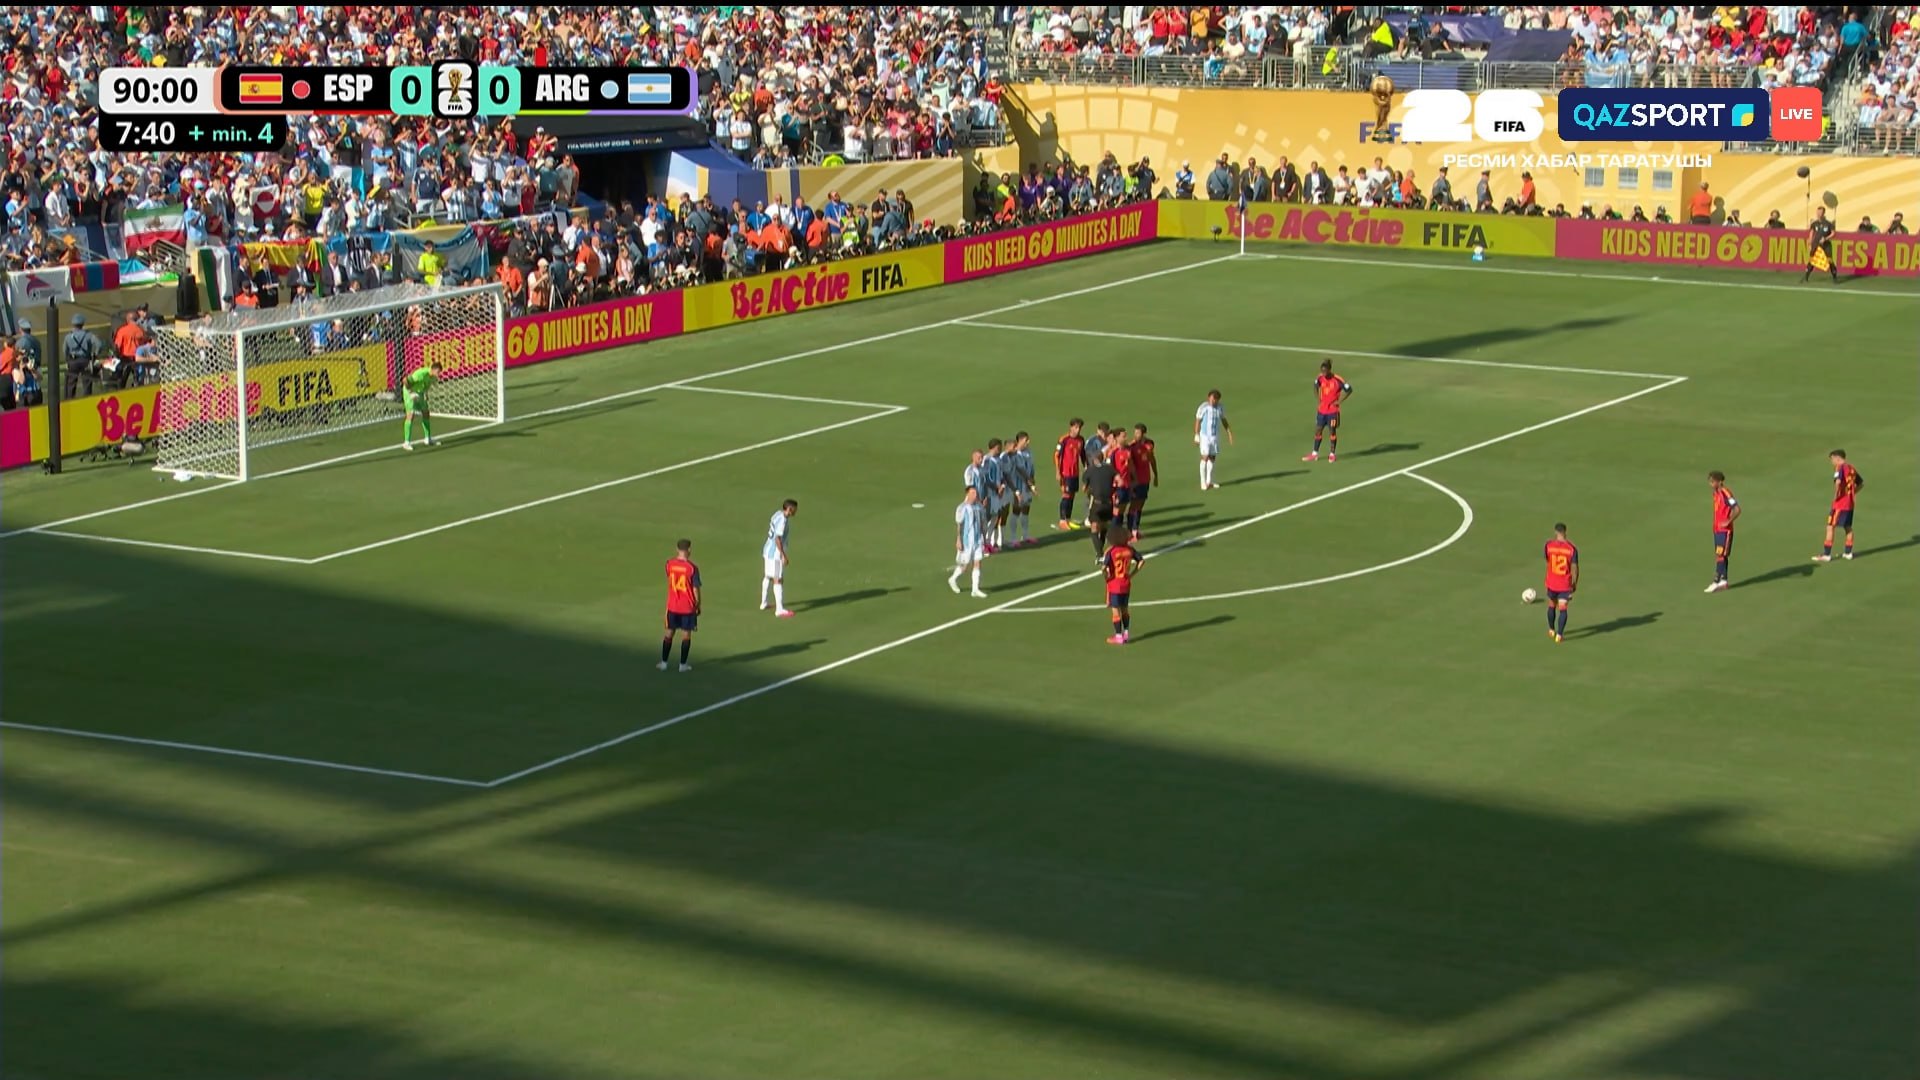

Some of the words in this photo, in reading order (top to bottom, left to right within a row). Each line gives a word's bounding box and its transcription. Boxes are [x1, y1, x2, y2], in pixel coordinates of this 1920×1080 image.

[964, 241, 993, 273] KIDS
[995, 234, 1026, 267] NEED
[1028, 228, 1054, 260] 60
[1056, 216, 1108, 253] MINUTES
[1109, 214, 1117, 241] A
[1119, 210, 1142, 239] DAY
[1423, 221, 1487, 248] FIFA
[1601, 227, 1651, 257] KIDS
[1656, 230, 1711, 260] NEED
[1716, 233, 1763, 263] 60
[1768, 237, 1869, 269] MINTES
[1873, 241, 1889, 269] A
[1894, 242, 1920, 270] DA
[730, 281, 764, 320] Be
[862, 263, 904, 294] FIFA
[464, 331, 497, 367] NEE
[507, 322, 540, 359] 60
[543, 308, 609, 353] MINUTES
[611, 308, 622, 338] A
[625, 302, 653, 336] DAY
[97, 396, 144, 441] Be
[278, 368, 333, 407] FIFA
[670, 572, 687, 593] 14
[1551, 554, 1567, 576] 12
